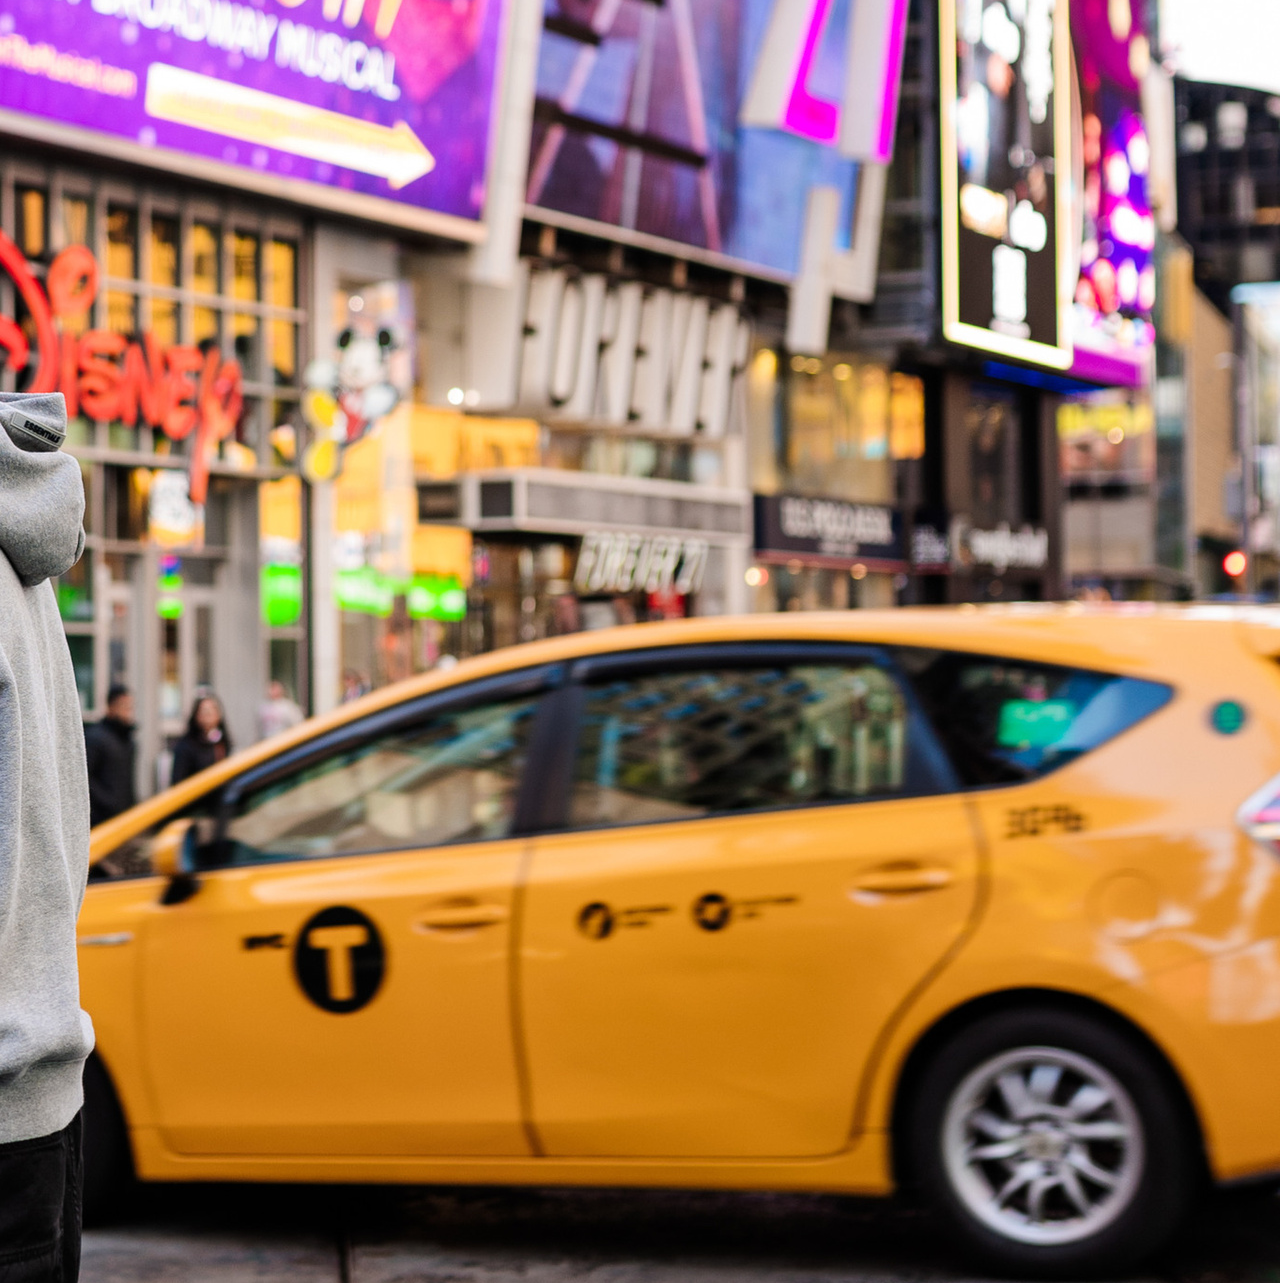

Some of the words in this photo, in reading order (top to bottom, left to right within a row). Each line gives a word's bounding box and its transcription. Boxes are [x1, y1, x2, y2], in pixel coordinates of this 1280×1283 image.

[275, 11, 401, 102] MUSICAL
[24, 420, 61, 443] ESSENTIALS
[308, 924, 370, 1002] T
